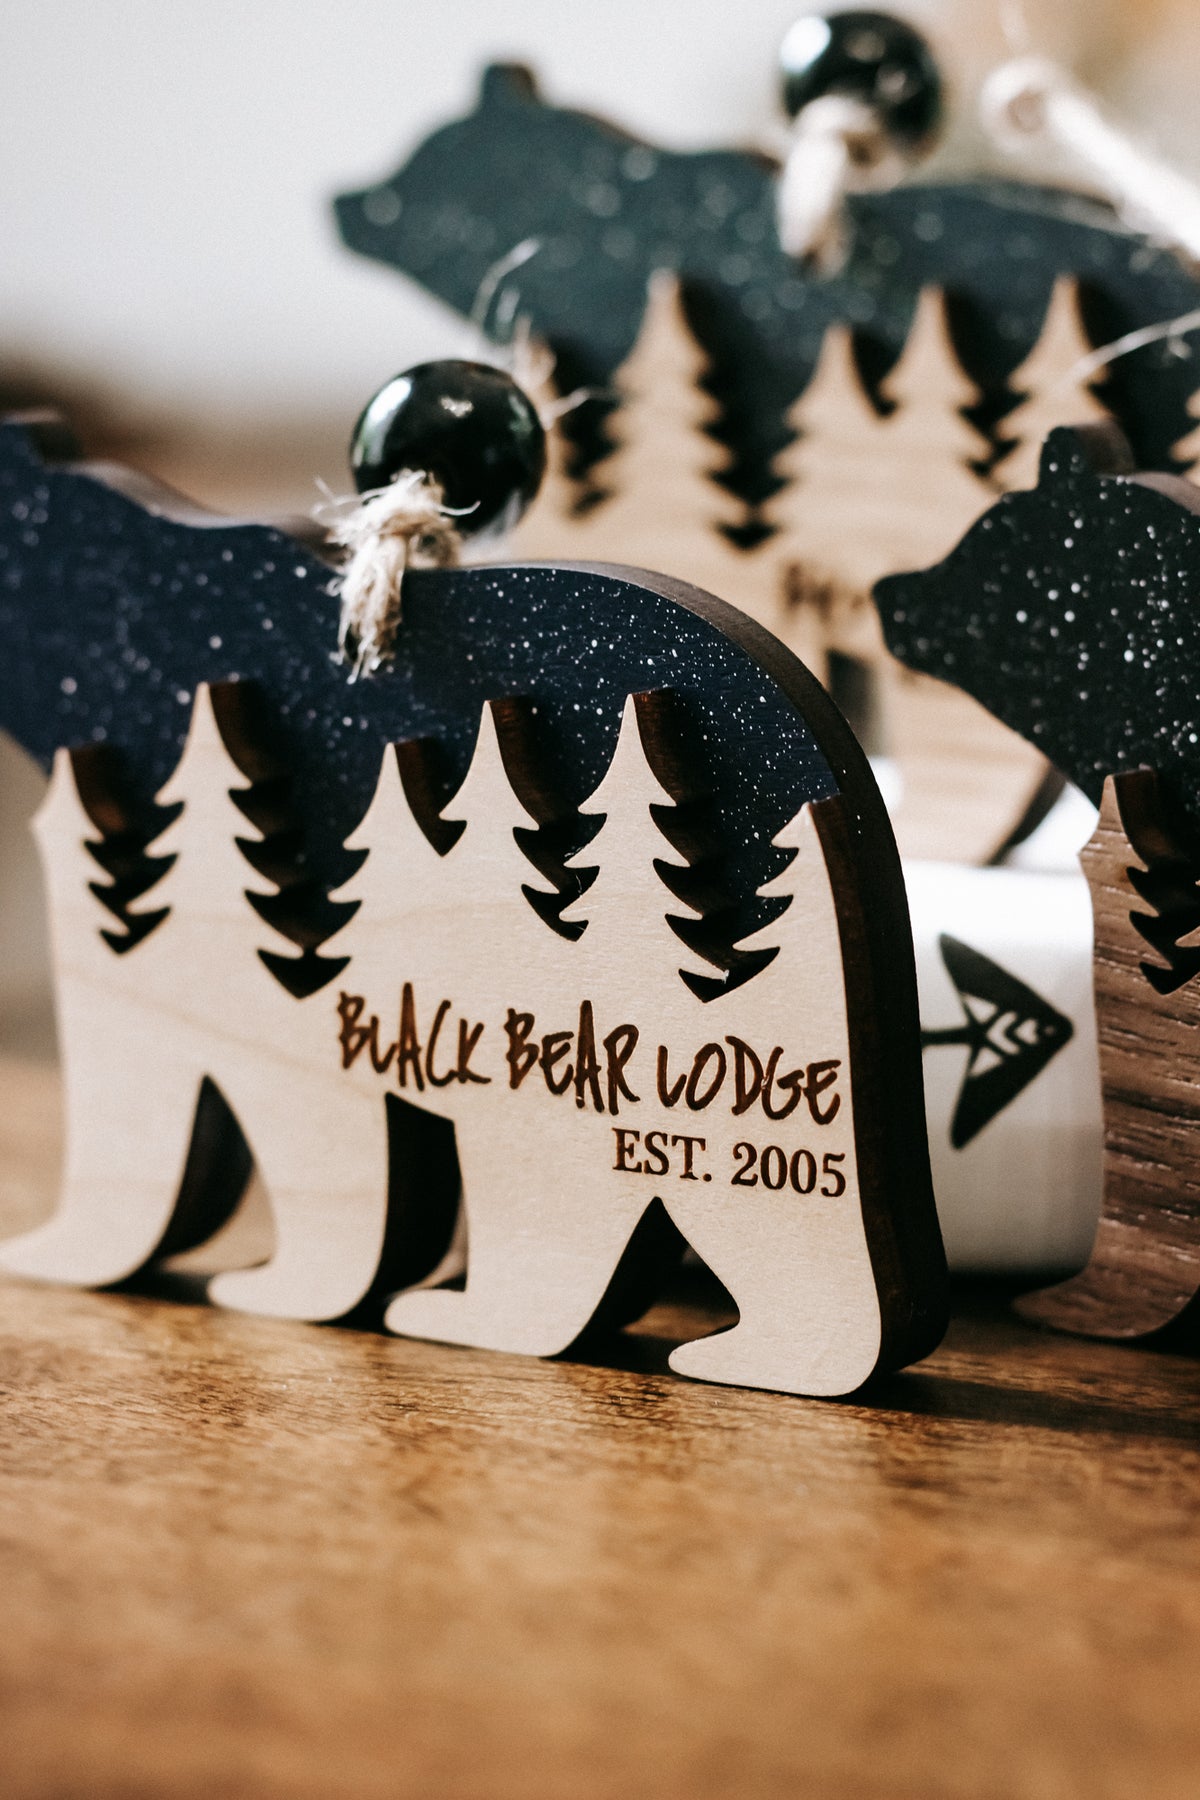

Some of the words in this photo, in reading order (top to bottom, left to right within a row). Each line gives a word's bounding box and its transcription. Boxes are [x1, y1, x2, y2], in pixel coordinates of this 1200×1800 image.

[337, 982, 492, 1091] BLACK
[503, 999, 640, 1116] BEAR
[657, 1035, 841, 1125] LODGE
[611, 1127, 713, 1182] EST.
[731, 1141, 847, 1198] 2005
